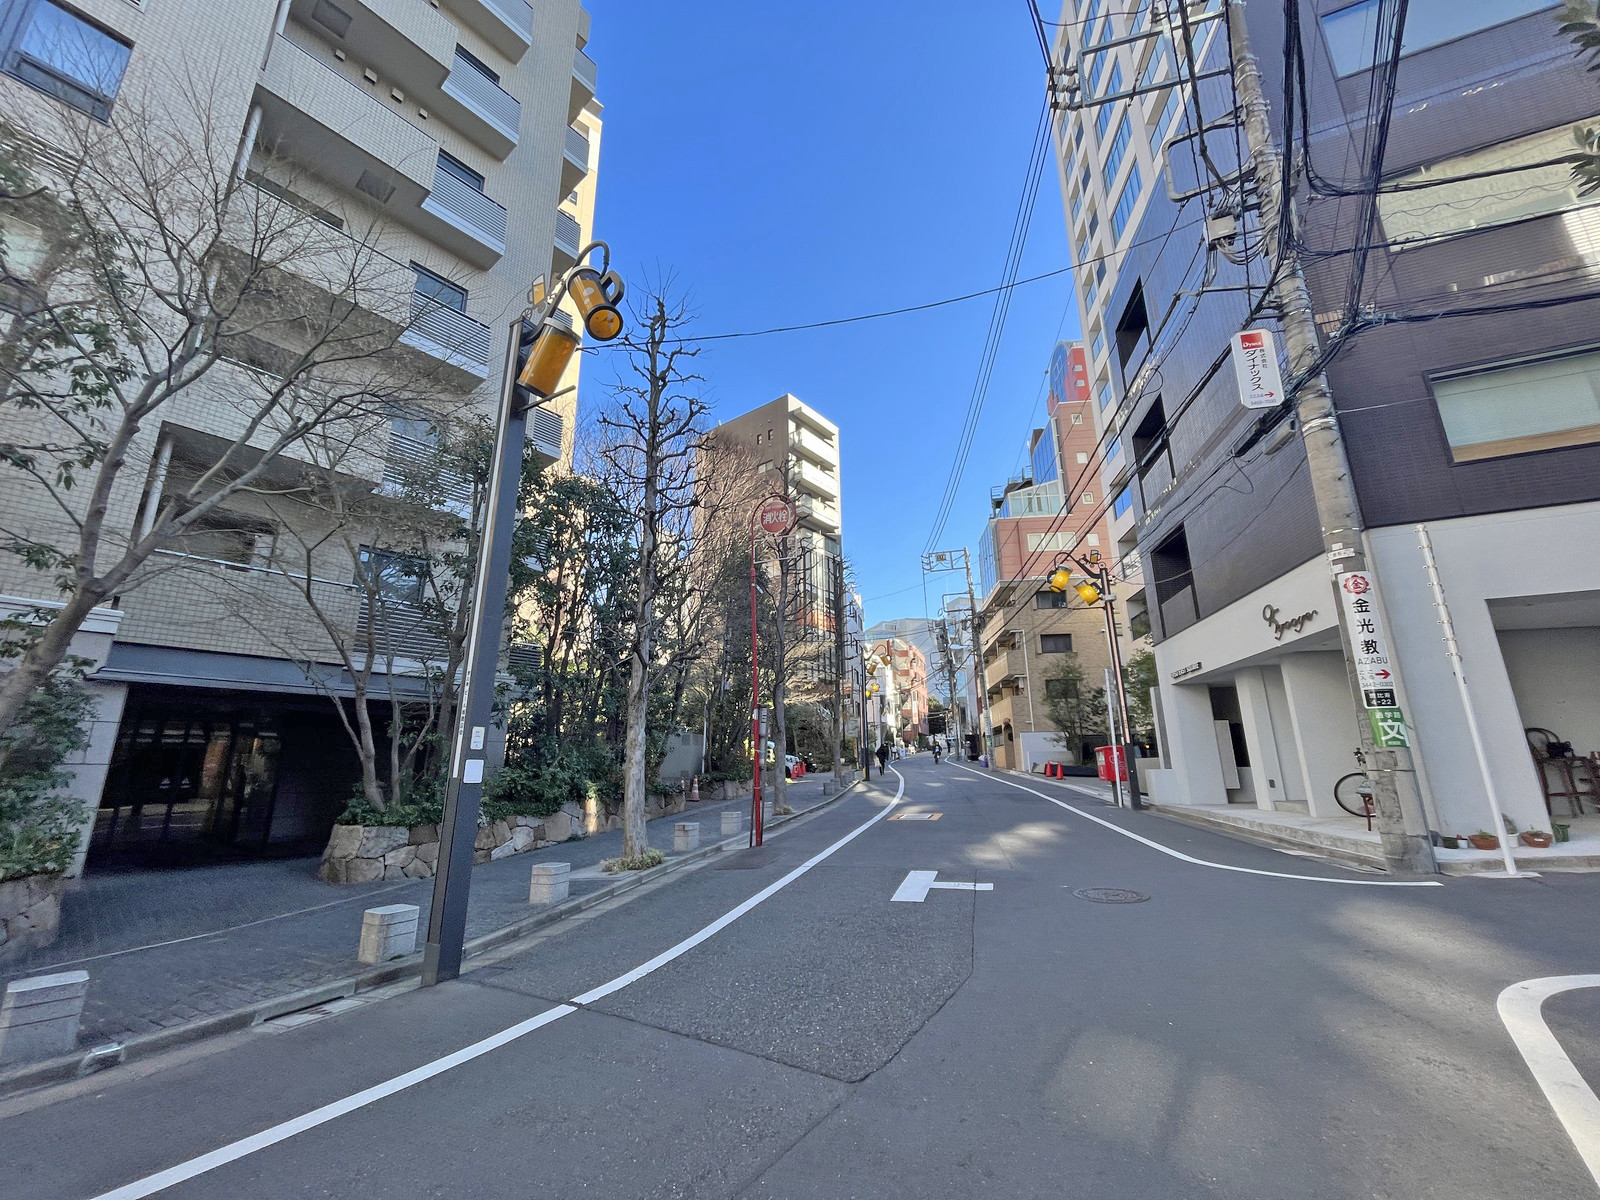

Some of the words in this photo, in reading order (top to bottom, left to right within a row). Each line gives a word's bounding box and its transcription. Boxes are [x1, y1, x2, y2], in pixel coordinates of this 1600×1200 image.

[1244, 348, 1264, 391] ダイナックス
[763, 510, 788, 525] 消火栓
[1352, 598, 1380, 655] 金光教
[1357, 656, 1388, 665] AZABU
